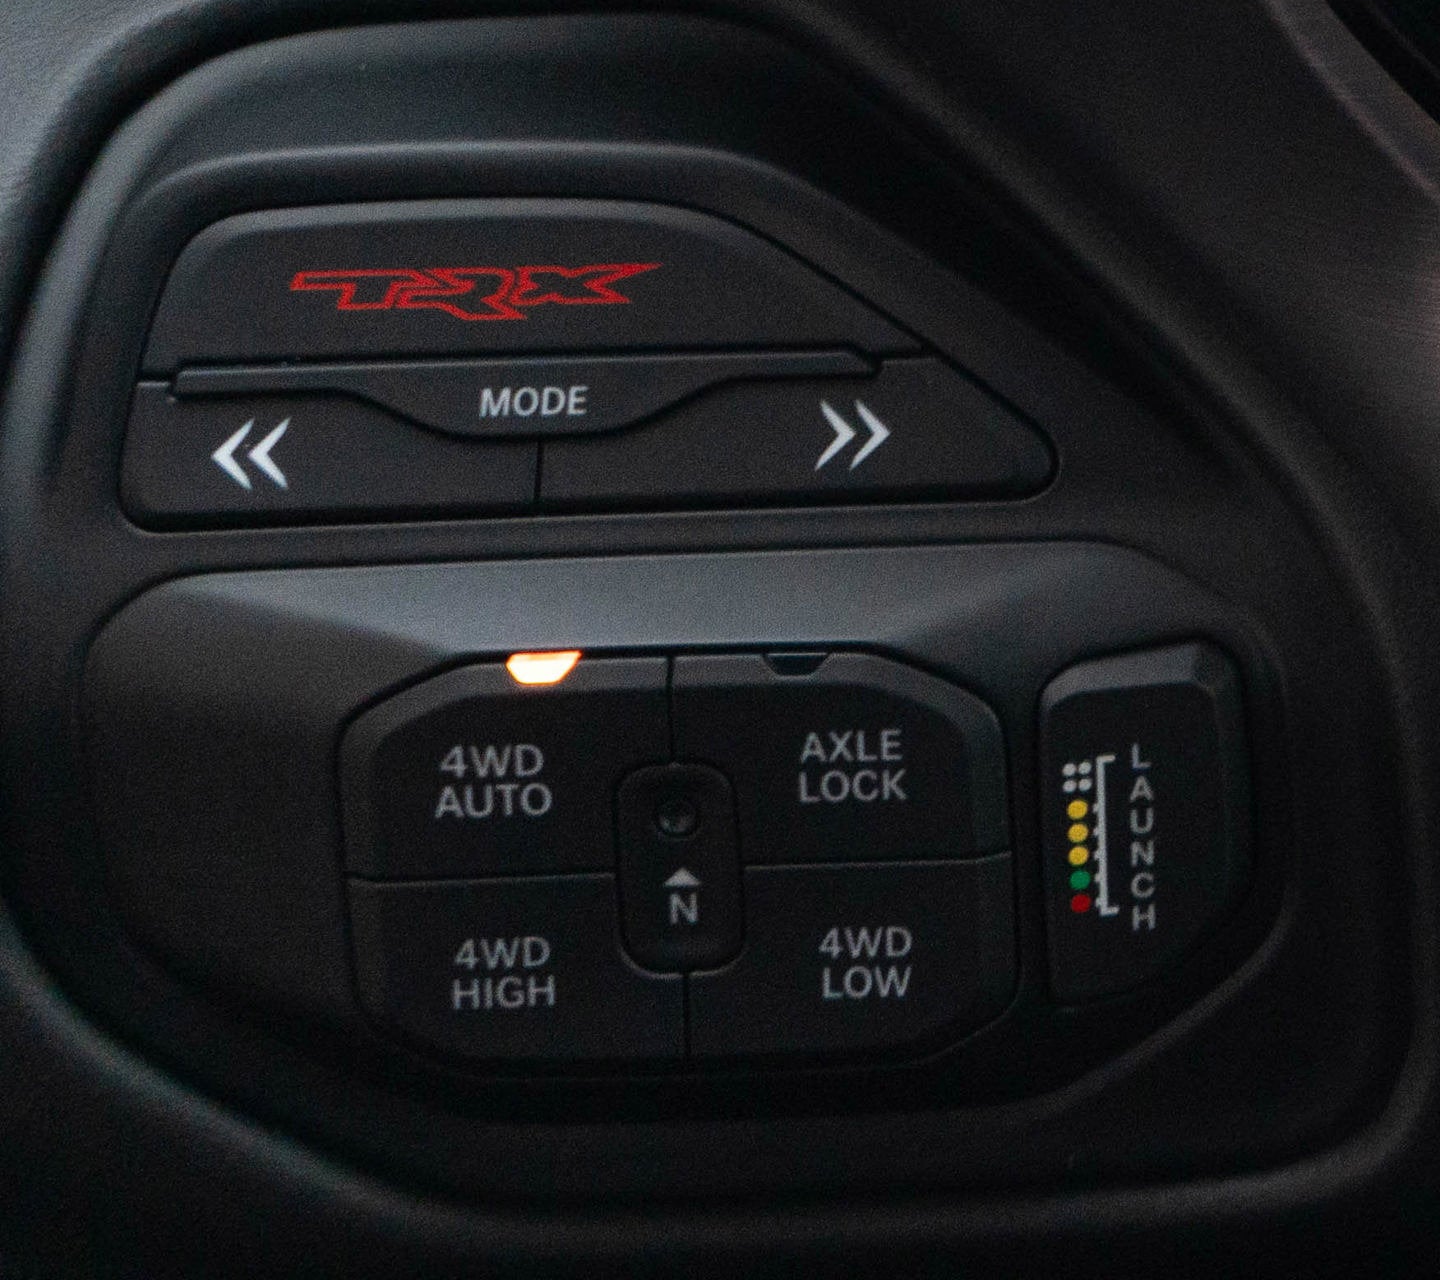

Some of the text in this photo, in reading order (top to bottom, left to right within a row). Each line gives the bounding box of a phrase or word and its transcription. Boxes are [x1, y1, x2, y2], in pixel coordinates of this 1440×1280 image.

[289, 262, 661, 322] TRX
[478, 386, 588, 418] MODE
[440, 744, 545, 780] 4WD
[800, 729, 903, 765] AXLE
[435, 781, 552, 820] AUTO
[800, 767, 906, 803] LOCK
[1128, 744, 1157, 931] LAUNCH
[670, 894, 698, 925] N
[454, 936, 551, 971] 4WD
[819, 926, 912, 960] 4WD
[452, 974, 556, 1010] HIGH
[821, 964, 911, 1000] LOW
